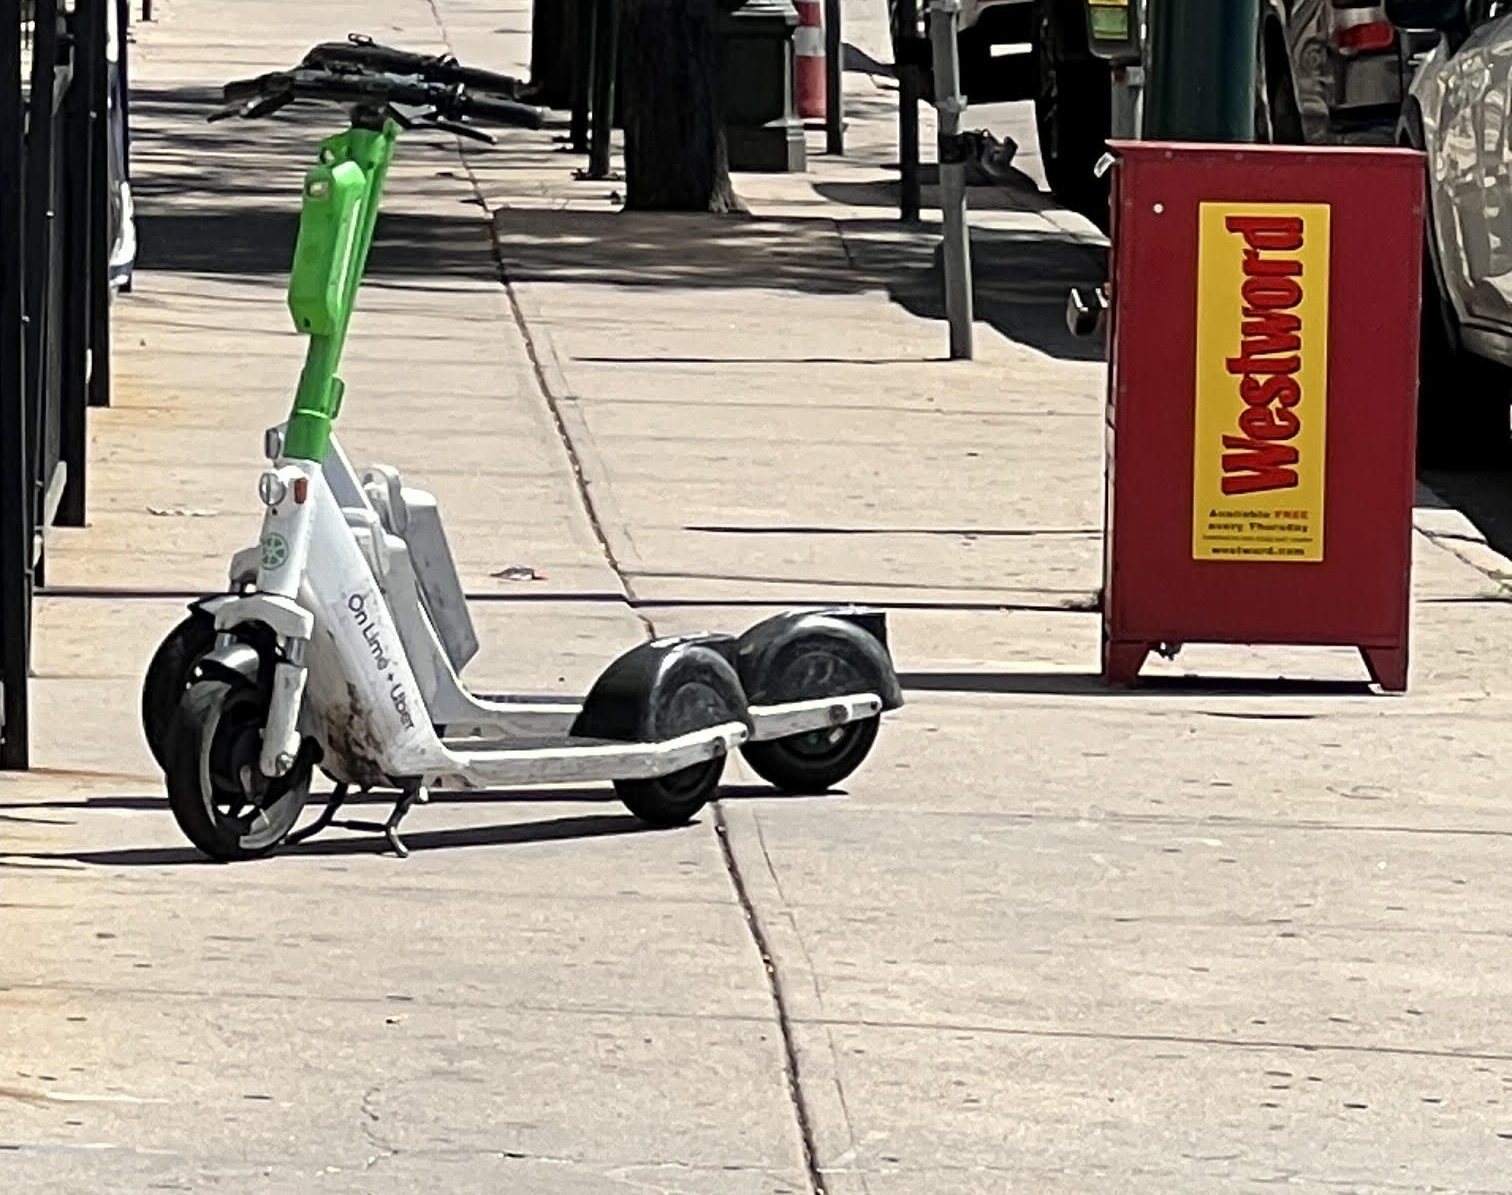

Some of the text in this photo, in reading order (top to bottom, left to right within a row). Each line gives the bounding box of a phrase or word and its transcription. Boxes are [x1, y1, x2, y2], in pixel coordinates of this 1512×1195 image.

[1221, 215, 1305, 496] Westword
[1249, 522, 1308, 533] Thursday
[1274, 510, 1309, 519] FREE
[348, 594, 368, 626] On
[362, 622, 390, 670] Lime
[390, 683, 415, 732] Uber
